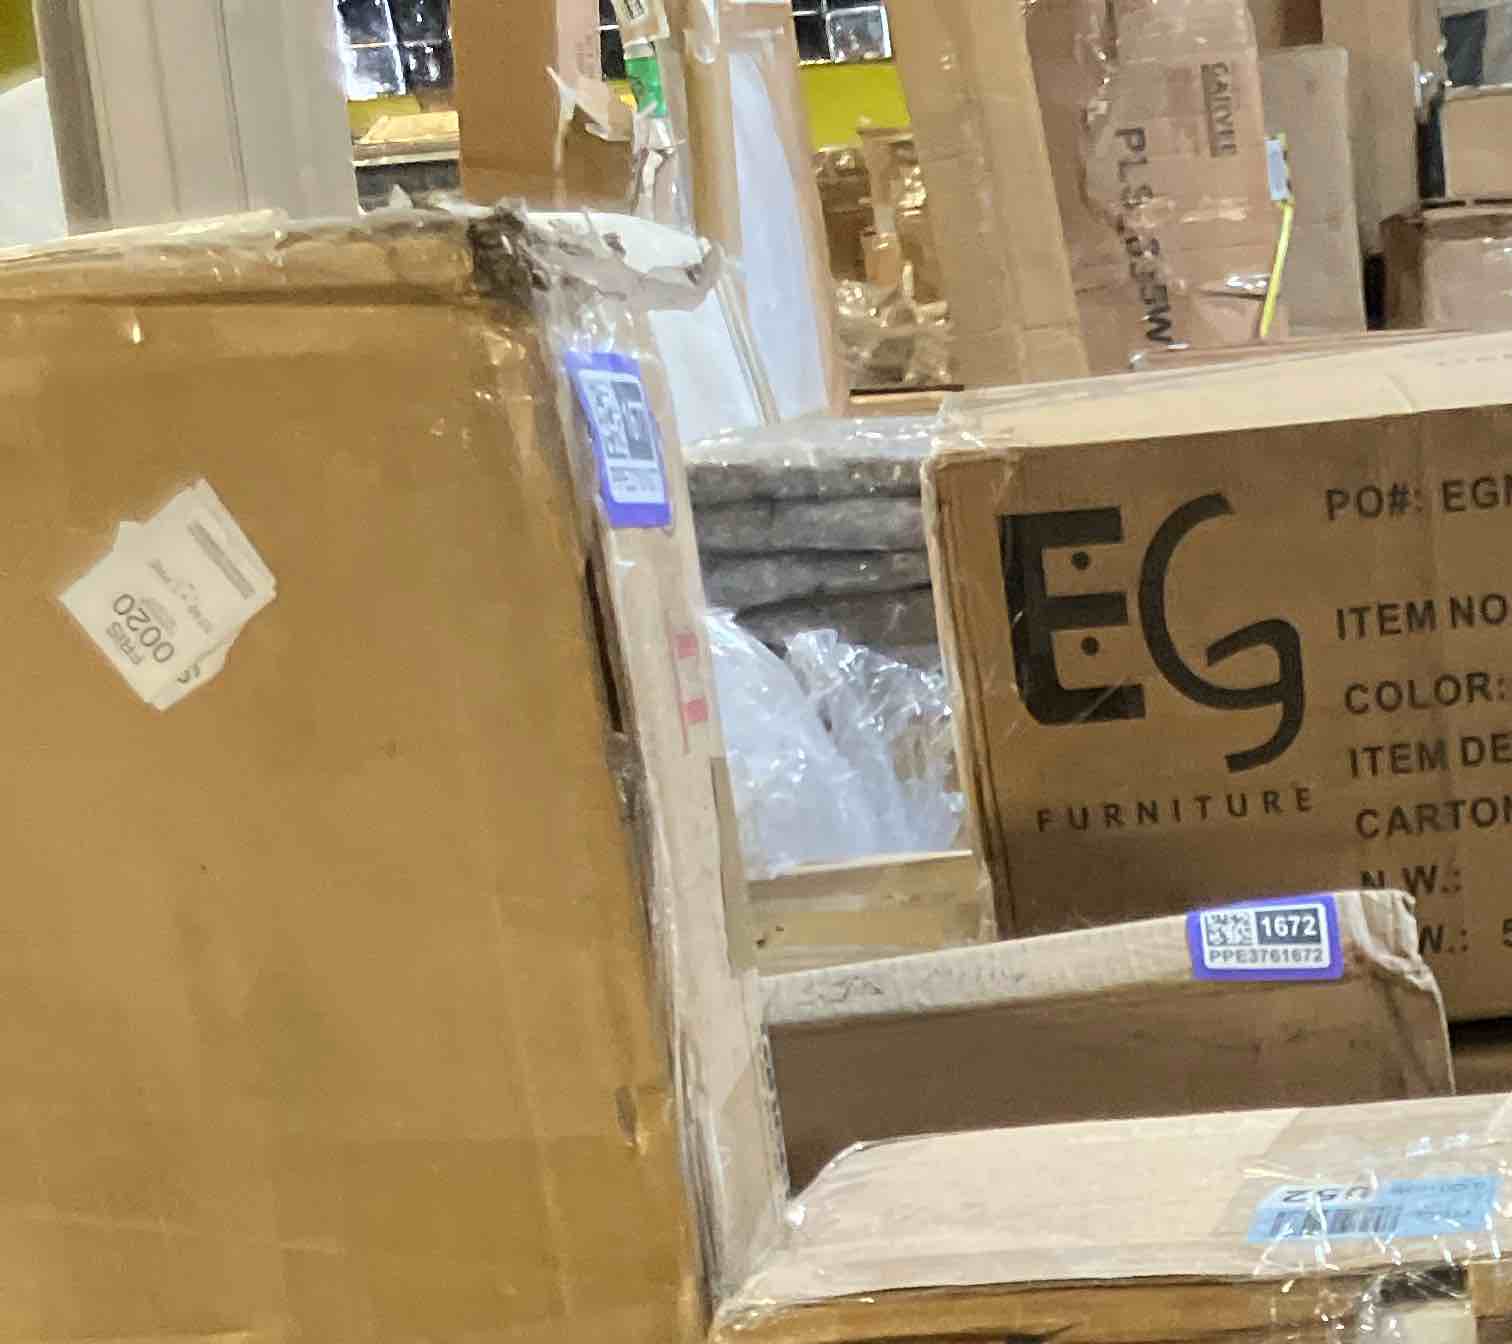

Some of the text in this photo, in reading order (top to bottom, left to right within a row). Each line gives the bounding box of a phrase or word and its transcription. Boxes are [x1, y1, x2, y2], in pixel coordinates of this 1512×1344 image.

[1325, 483, 1424, 521] PO#:
[1335, 599, 1438, 641] ITEM
[1343, 671, 1507, 715] COLOR:
[1347, 735, 1450, 778] ITEM
[1036, 786, 1314, 833] FURNITURE
[1360, 863, 1462, 895] NW.:
[1261, 914, 1318, 937] 1672
